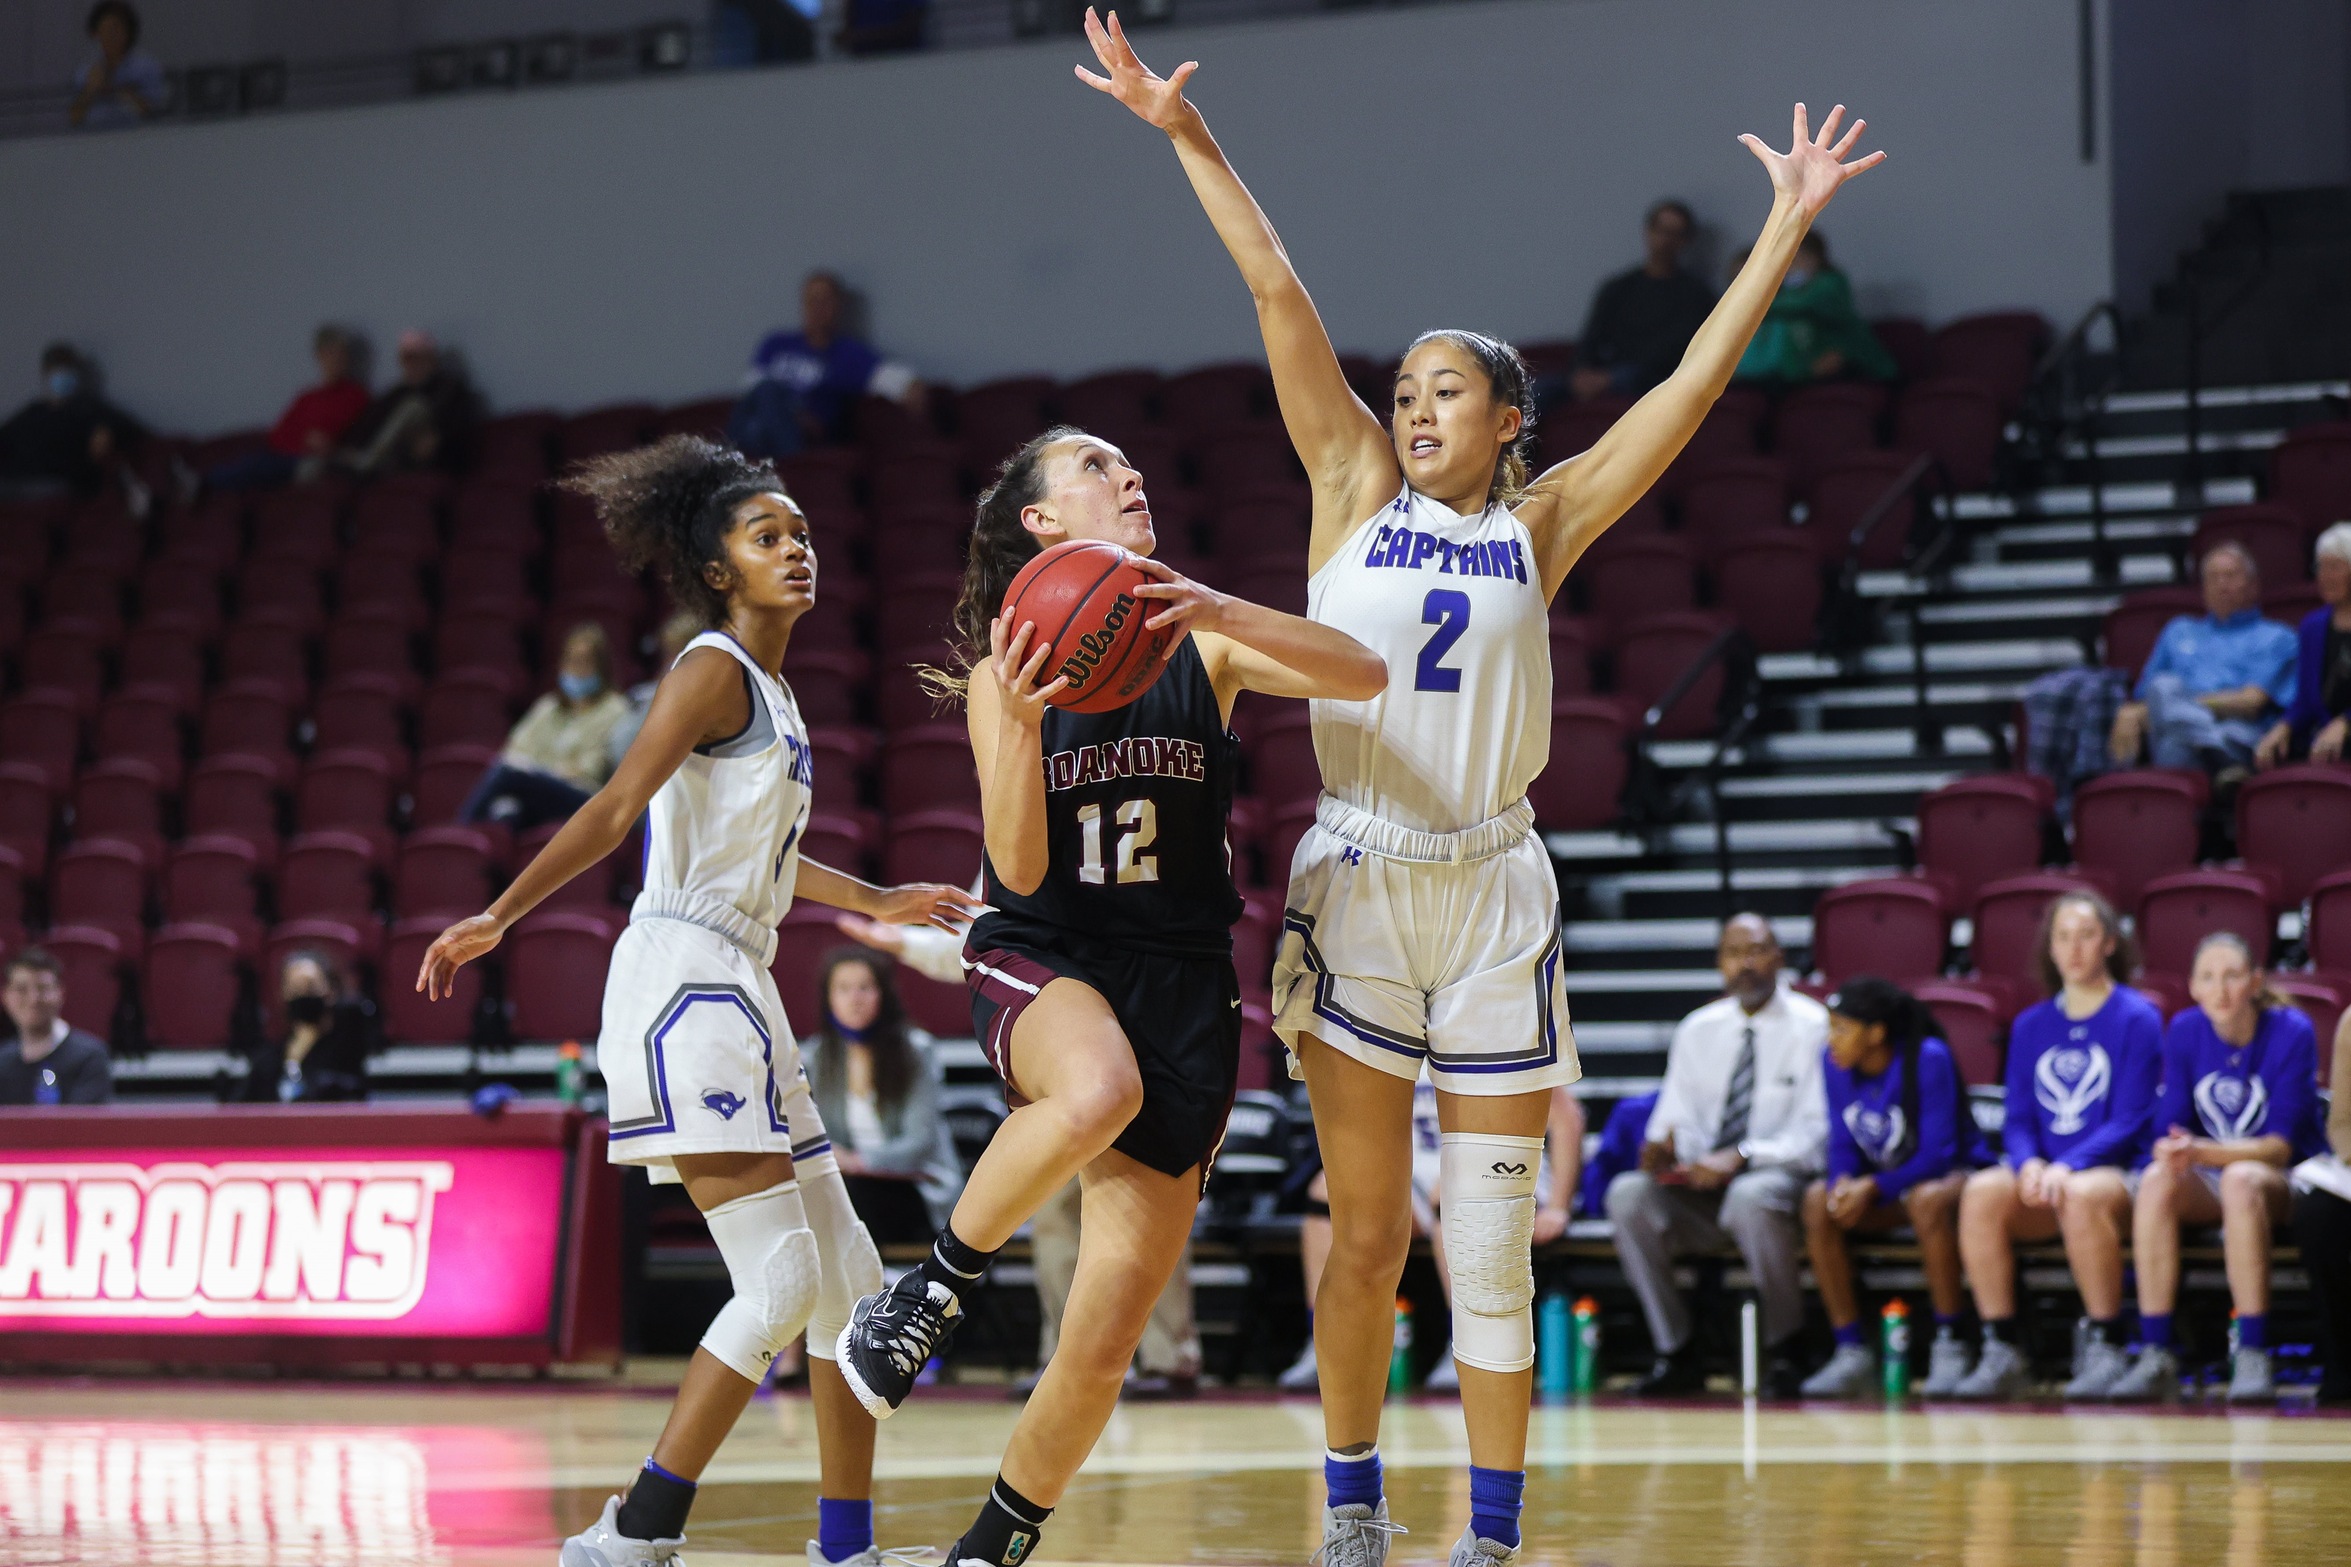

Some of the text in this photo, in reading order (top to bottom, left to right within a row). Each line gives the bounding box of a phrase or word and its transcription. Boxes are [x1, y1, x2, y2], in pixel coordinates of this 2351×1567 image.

[1365, 524, 1528, 585] CAPTAINS
[1052, 592, 1137, 690] Wilson
[1414, 588, 1471, 693] 2
[1076, 798, 1160, 885] 12
[0, 1172, 430, 1308] AROONS
